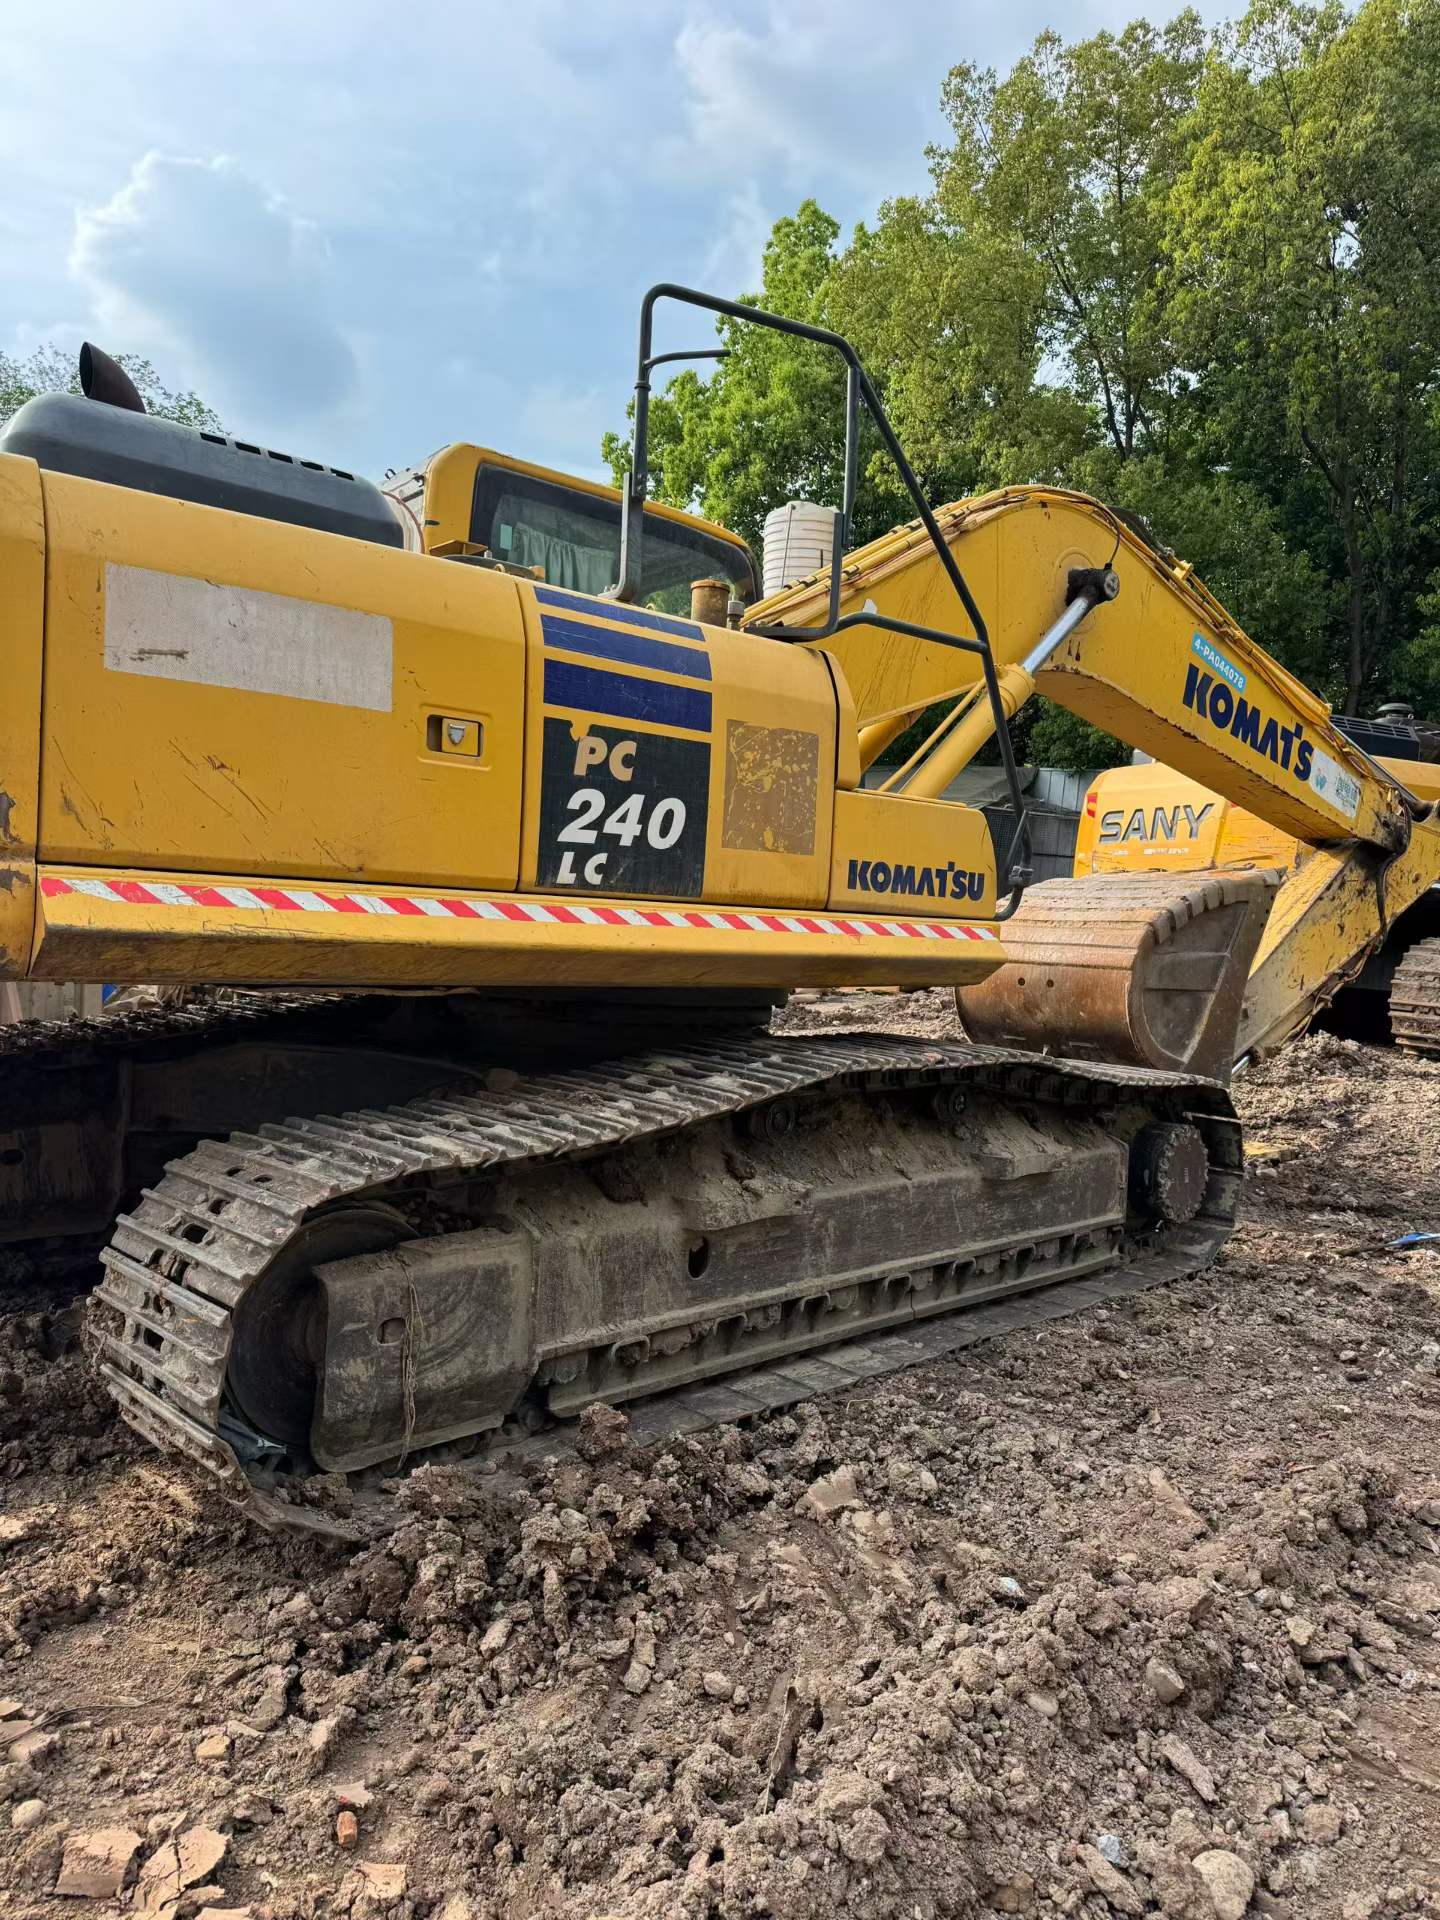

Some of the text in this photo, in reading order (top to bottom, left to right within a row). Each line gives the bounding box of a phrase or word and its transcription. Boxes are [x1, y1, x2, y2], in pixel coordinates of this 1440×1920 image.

[1183, 662, 1314, 781] KOMATS
[574, 736, 637, 781] PC
[557, 788, 686, 850] 240
[1099, 803, 1215, 842] SANY
[556, 851, 608, 885] LC
[847, 859, 985, 901] KOMATSU
